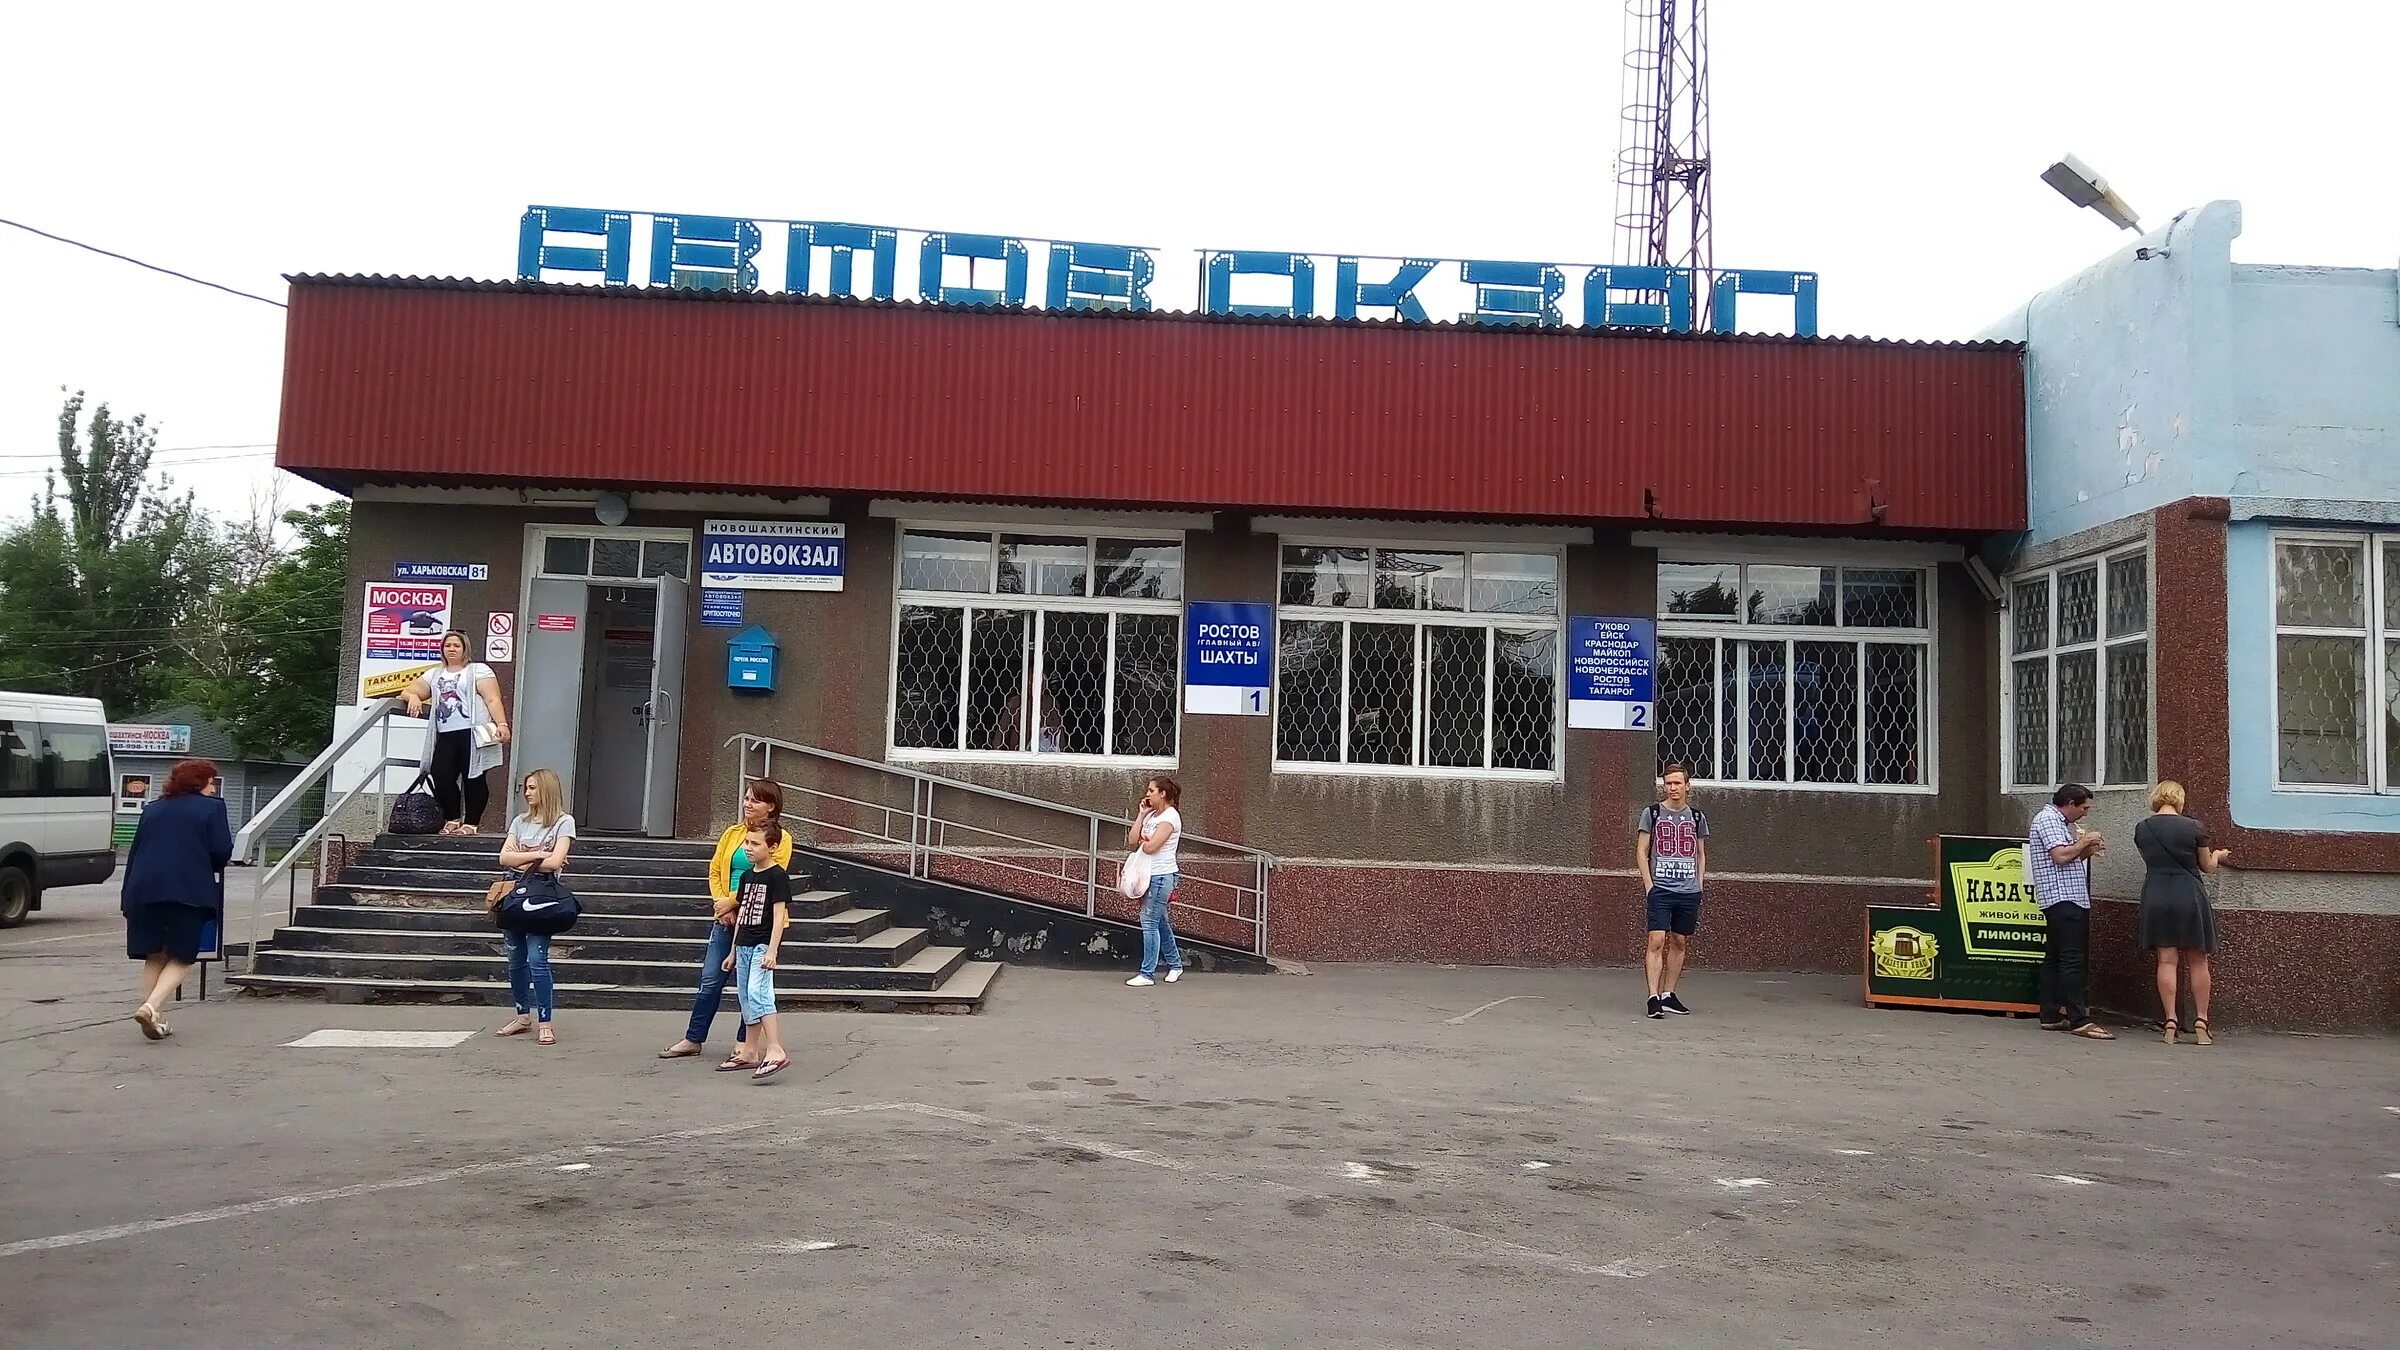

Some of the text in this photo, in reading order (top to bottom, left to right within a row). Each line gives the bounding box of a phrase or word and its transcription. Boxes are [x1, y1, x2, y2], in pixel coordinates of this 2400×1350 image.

[710, 523, 839, 536] НОВОШАХТИНСКИЙ
[708, 542, 839, 567] АВТОВОКЗАЛ
[397, 565, 485, 578] ул. ХАРЬКОВСКАЯ 81
[372, 590, 445, 606] МОСКВА
[1199, 624, 1260, 639] РОСТОВ
[1594, 622, 1630, 631] ГУКОВО
[1600, 631, 1624, 639] ЕЙСК
[1585, 640, 1639, 649] КРАСНОДАР
[1200, 650, 1258, 665] ШАХТЫ
[1593, 649, 1631, 657] МАЙКОП
[1574, 657, 1650, 667] НОВОРОССИЙСК
[1575, 666, 1648, 676] НОВОЧЕРКАССК
[367, 673, 401, 686] ТАКСИ
[1593, 675, 1630, 684] РОСТОВ
[1589, 687, 1634, 696] ТАГАНРОГ
[1250, 690, 1261, 712] 1
[1631, 705, 1646, 727] 2
[1655, 820, 1697, 857] 86
[1656, 861, 1696, 869] NEW YORK
[1665, 869, 1688, 878] CITY
[1966, 878, 2039, 904] КАЗАЧ
[1979, 910, 2019, 920] живой
